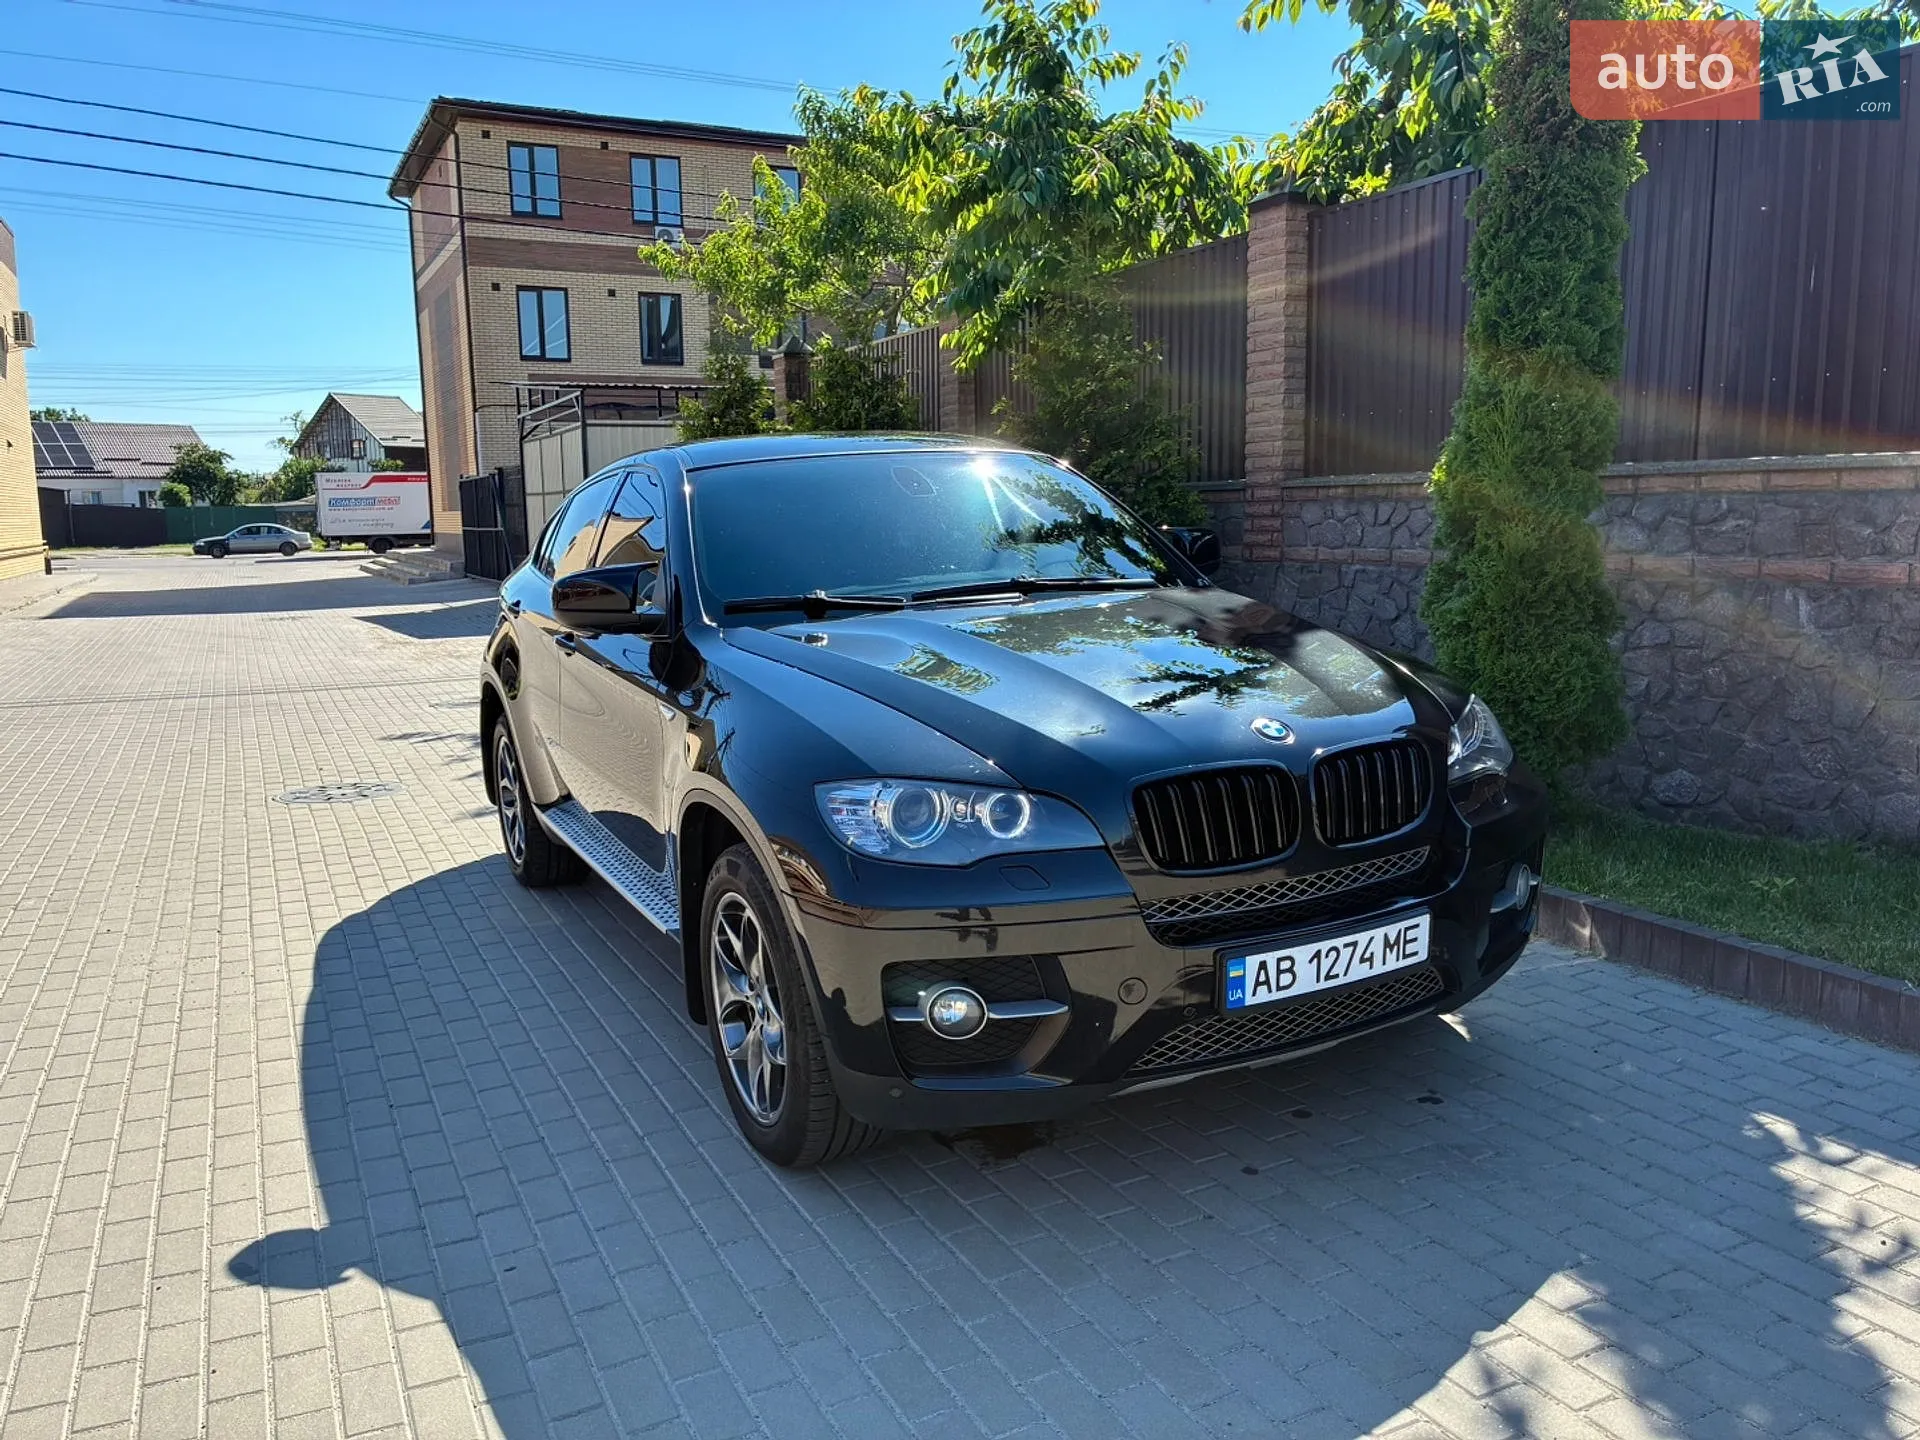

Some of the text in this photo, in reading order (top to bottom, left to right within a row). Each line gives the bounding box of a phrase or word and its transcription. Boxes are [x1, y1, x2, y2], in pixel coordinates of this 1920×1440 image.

[1251, 923, 1420, 997] AB 1274 ME
[1228, 989, 1243, 1001] UA
